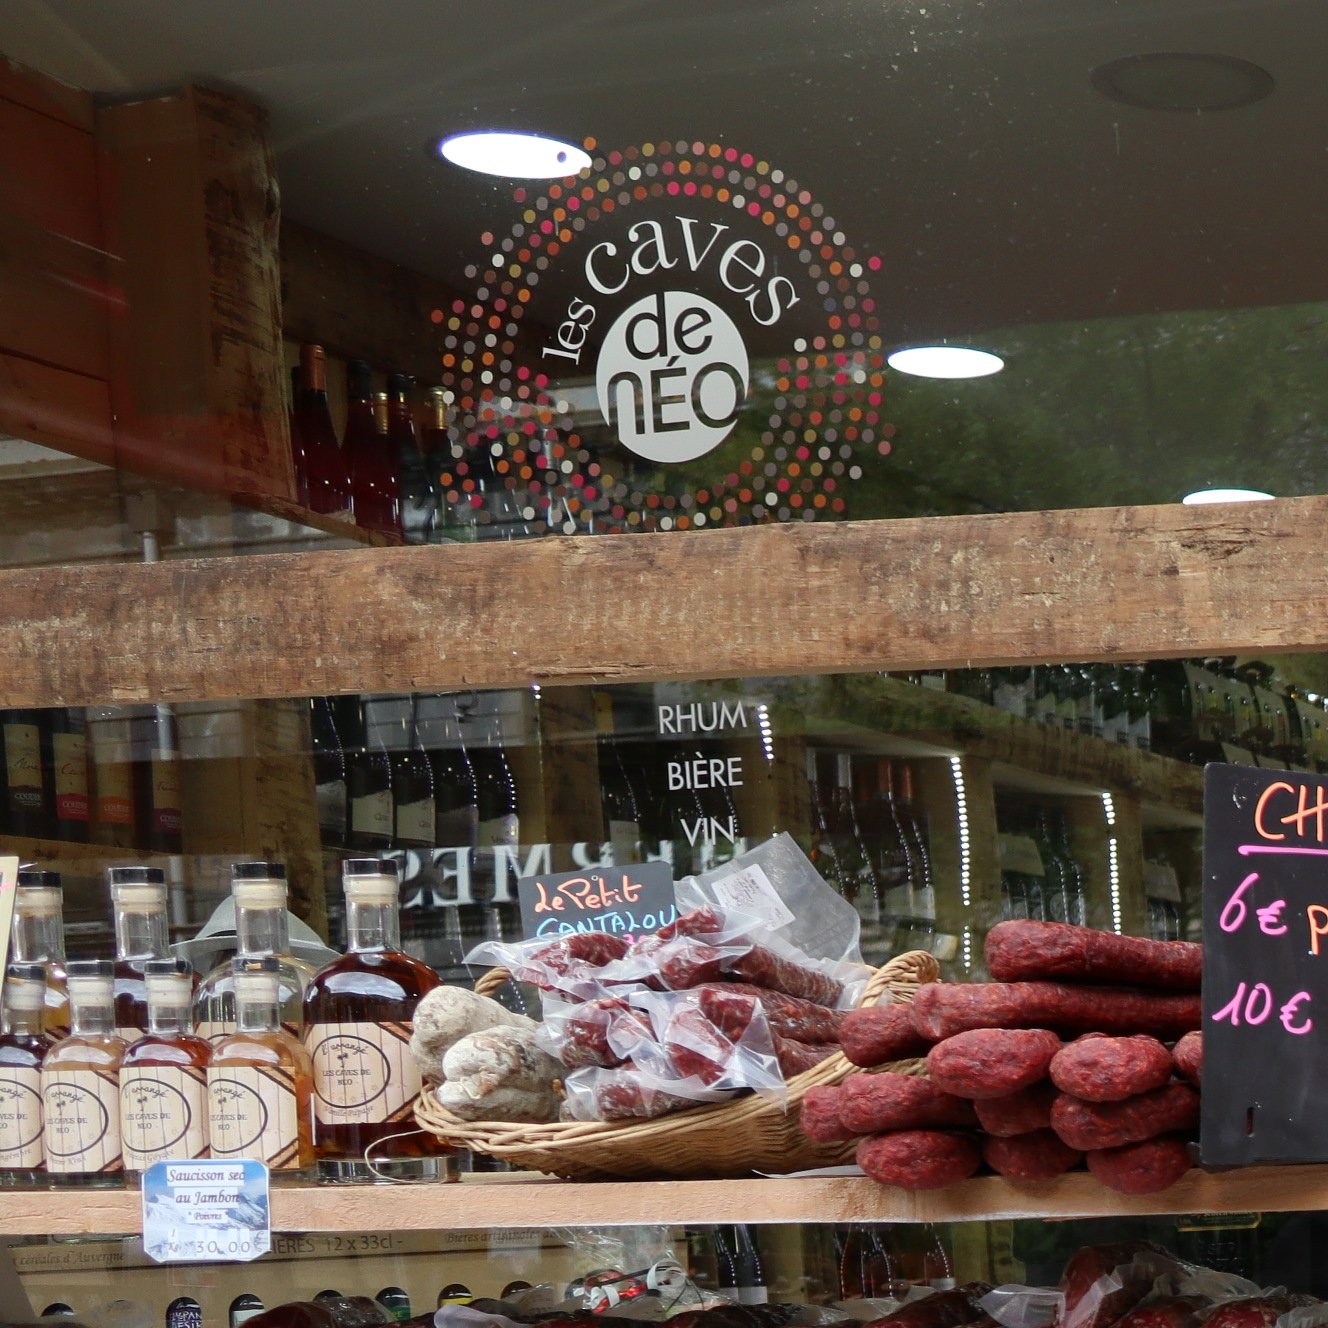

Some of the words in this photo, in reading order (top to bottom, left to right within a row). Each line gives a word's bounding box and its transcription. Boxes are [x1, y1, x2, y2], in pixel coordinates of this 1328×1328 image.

[543, 297, 597, 365] les
[585, 216, 801, 327] caves
[625, 291, 713, 361] de
[659, 701, 747, 734] RHUM
[668, 751, 744, 791] BIÈRE
[680, 816, 736, 847] VIN
[535, 882, 565, 913] Le
[558, 875, 644, 910] Petit
[167, 1168, 225, 1183] Saucisson
[227, 1172, 246, 1181] sec
[175, 1195, 192, 1204] au
[193, 1189, 240, 1206] Jambon
[325, 1236, 343, 1251] 12
[346, 1239, 358, 1251] x
[360, 1232, 393, 1250] 33cl
